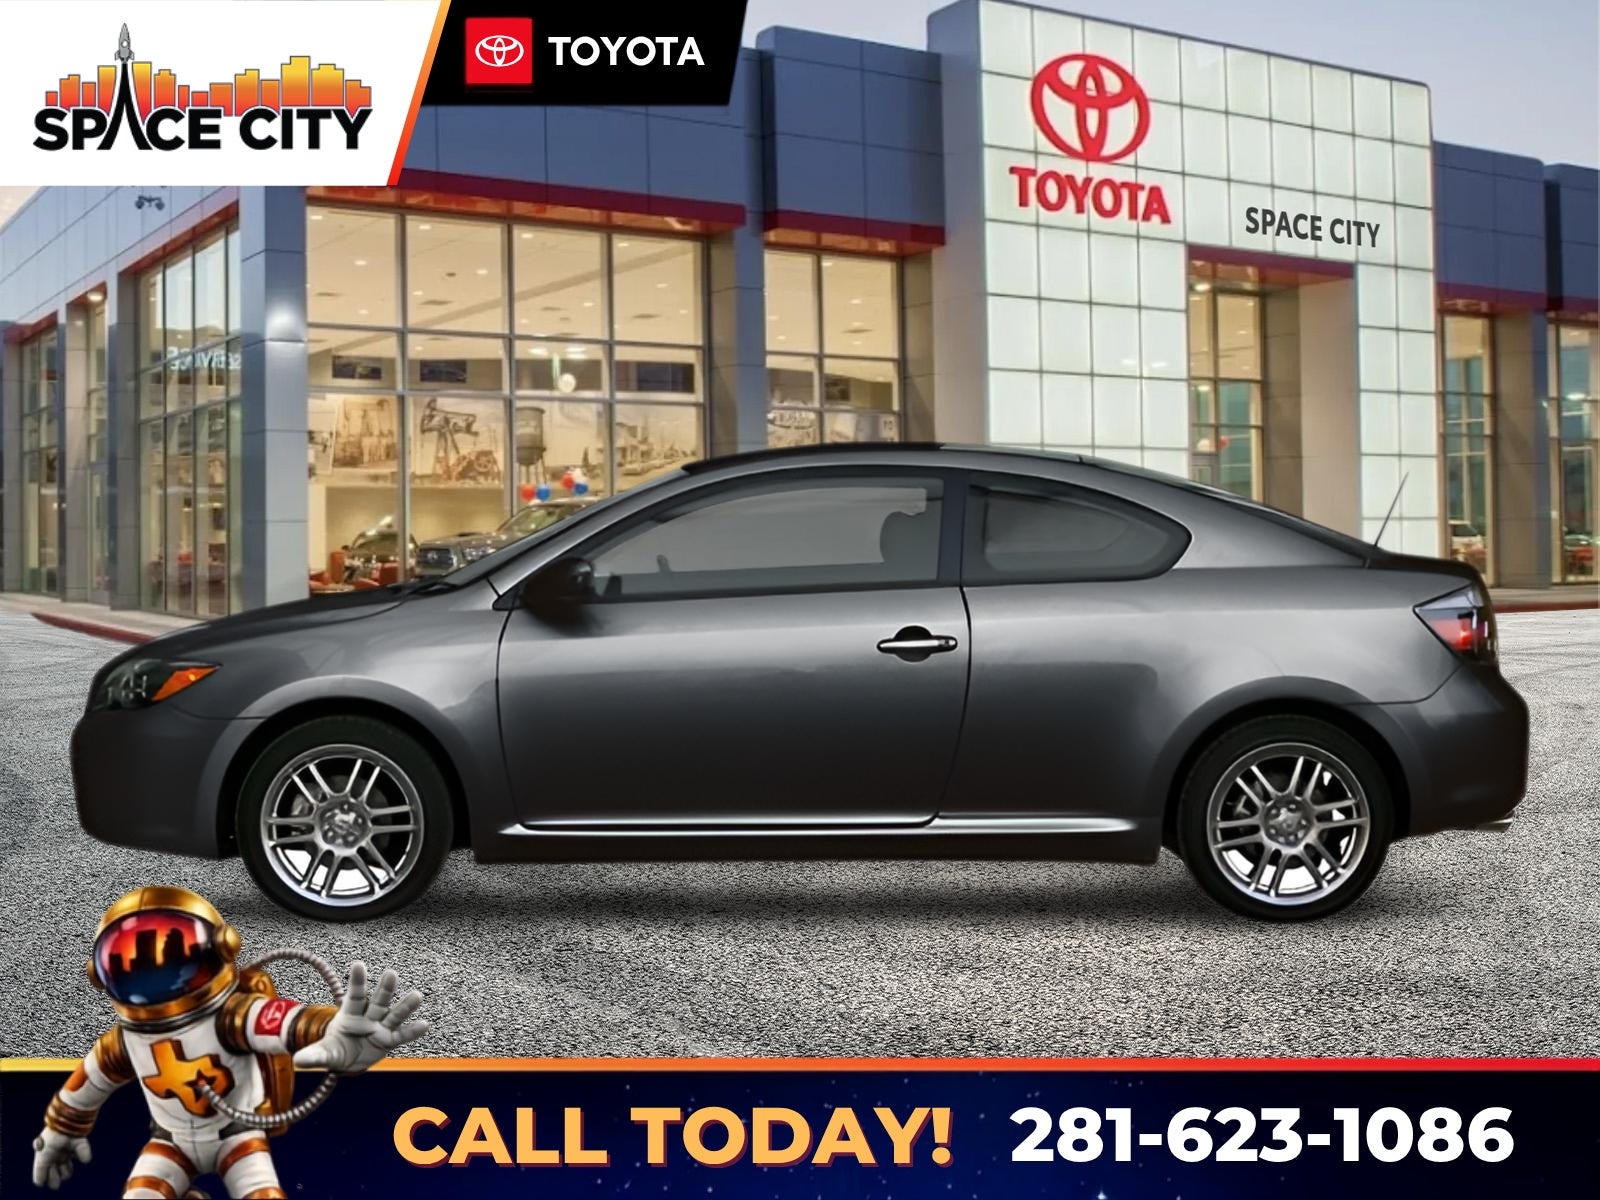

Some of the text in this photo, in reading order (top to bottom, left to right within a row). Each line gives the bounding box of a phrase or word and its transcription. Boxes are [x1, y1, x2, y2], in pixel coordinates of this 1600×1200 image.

[1009, 166, 1171, 224] TOYOTA
[1245, 207, 1381, 248] SPACE CITY
